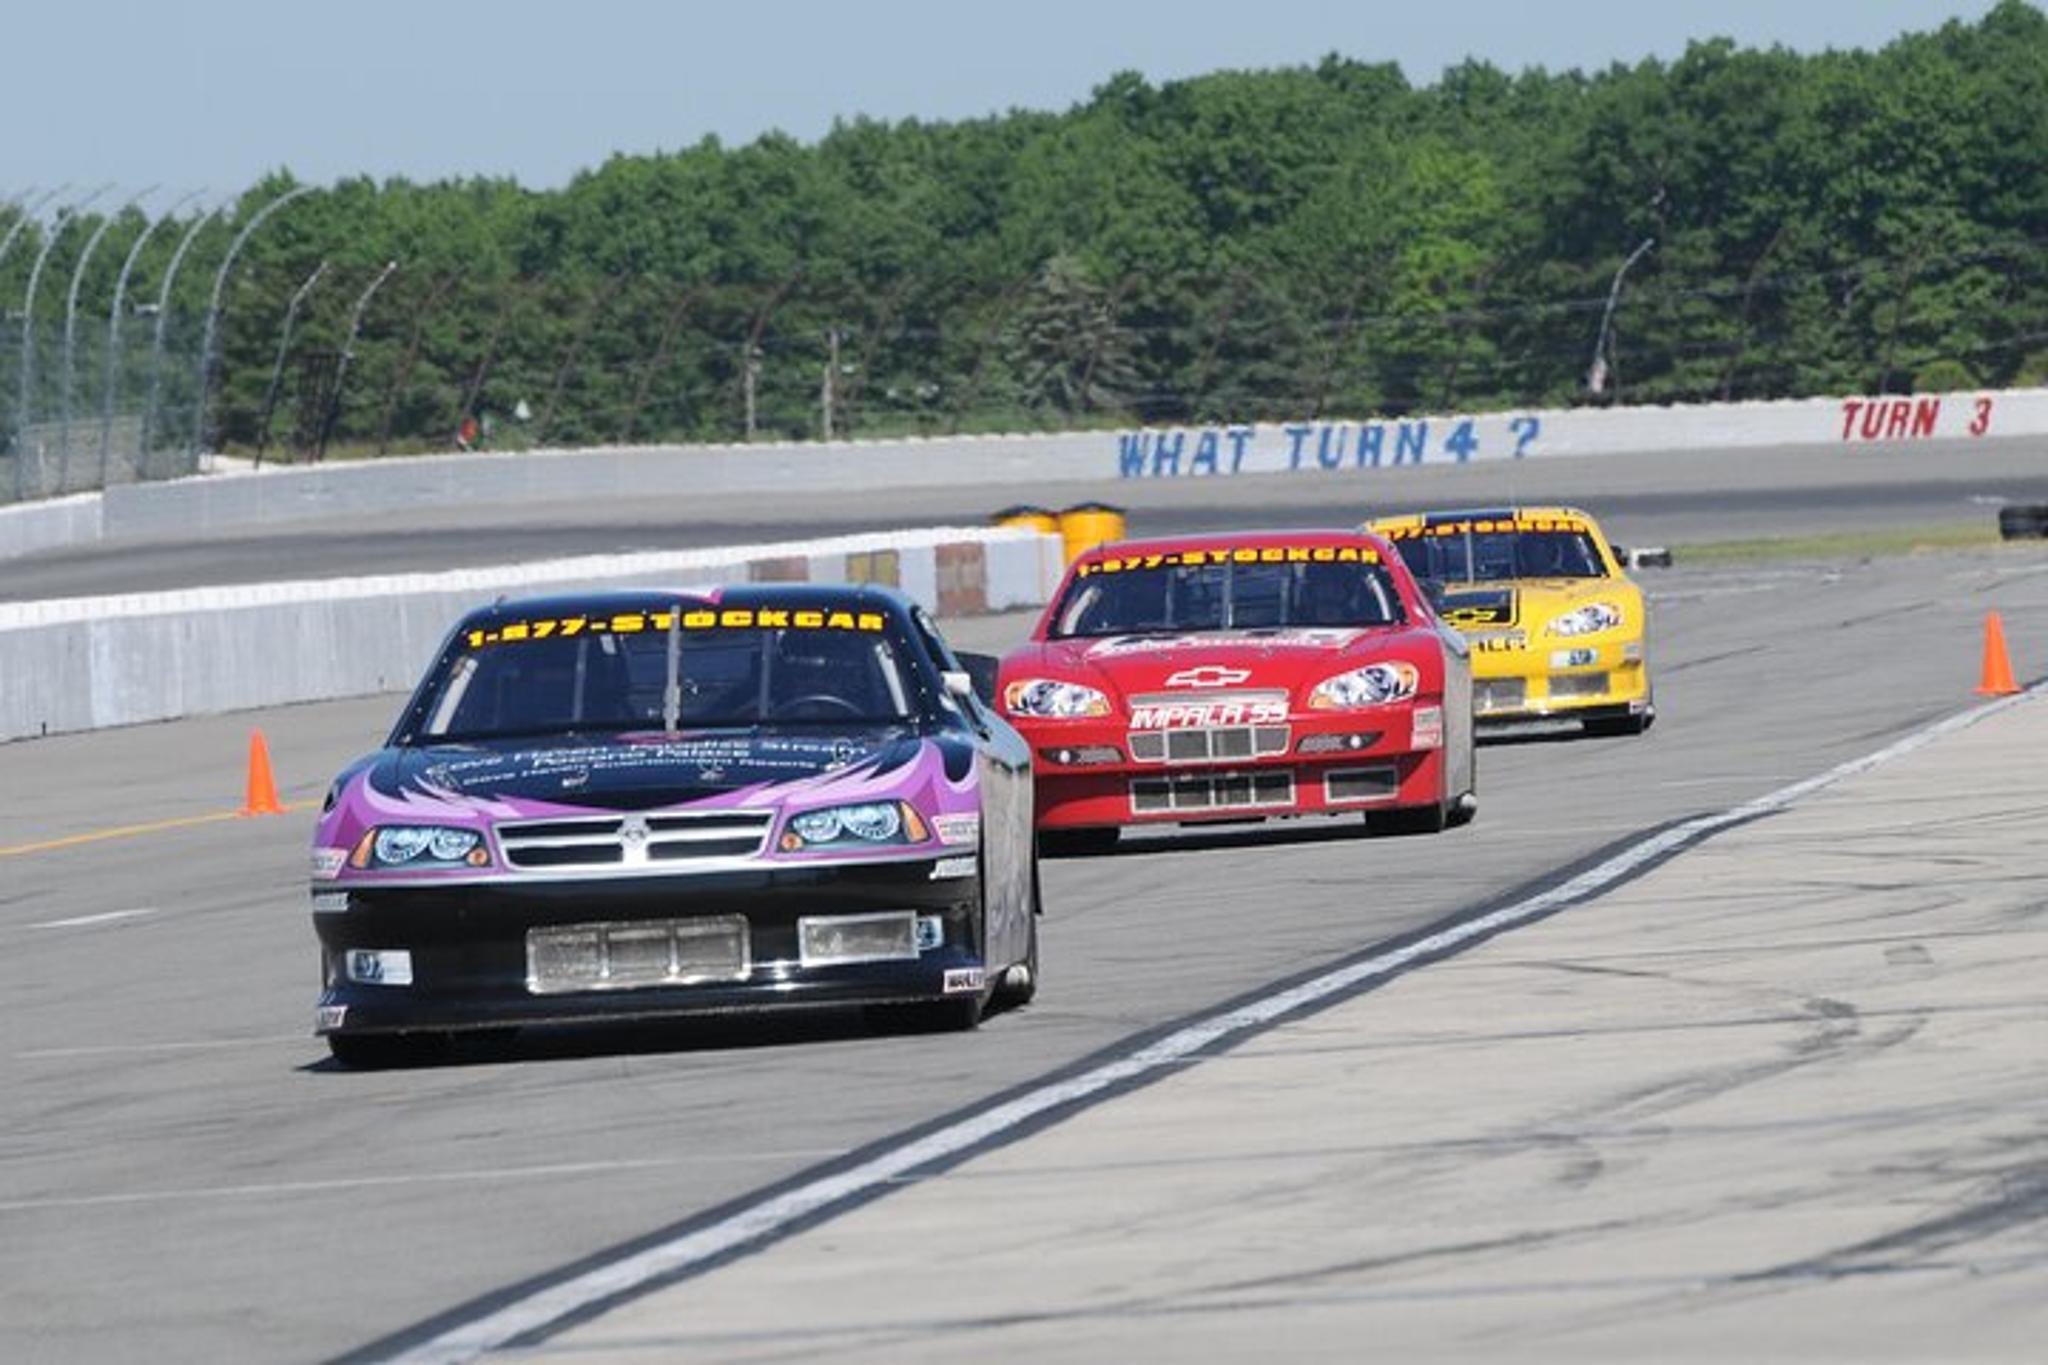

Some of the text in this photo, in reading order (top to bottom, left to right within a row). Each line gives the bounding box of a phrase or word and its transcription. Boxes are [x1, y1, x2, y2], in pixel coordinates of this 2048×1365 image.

[1843, 397, 1992, 440] TURN 3
[1118, 416, 1541, 477] WHAT TURN 4 ?
[1078, 547, 1379, 578] 1-877-STOCKCAR
[468, 610, 884, 648] 1-877-STOCKCAR
[1129, 704, 1246, 730] IMPALA
